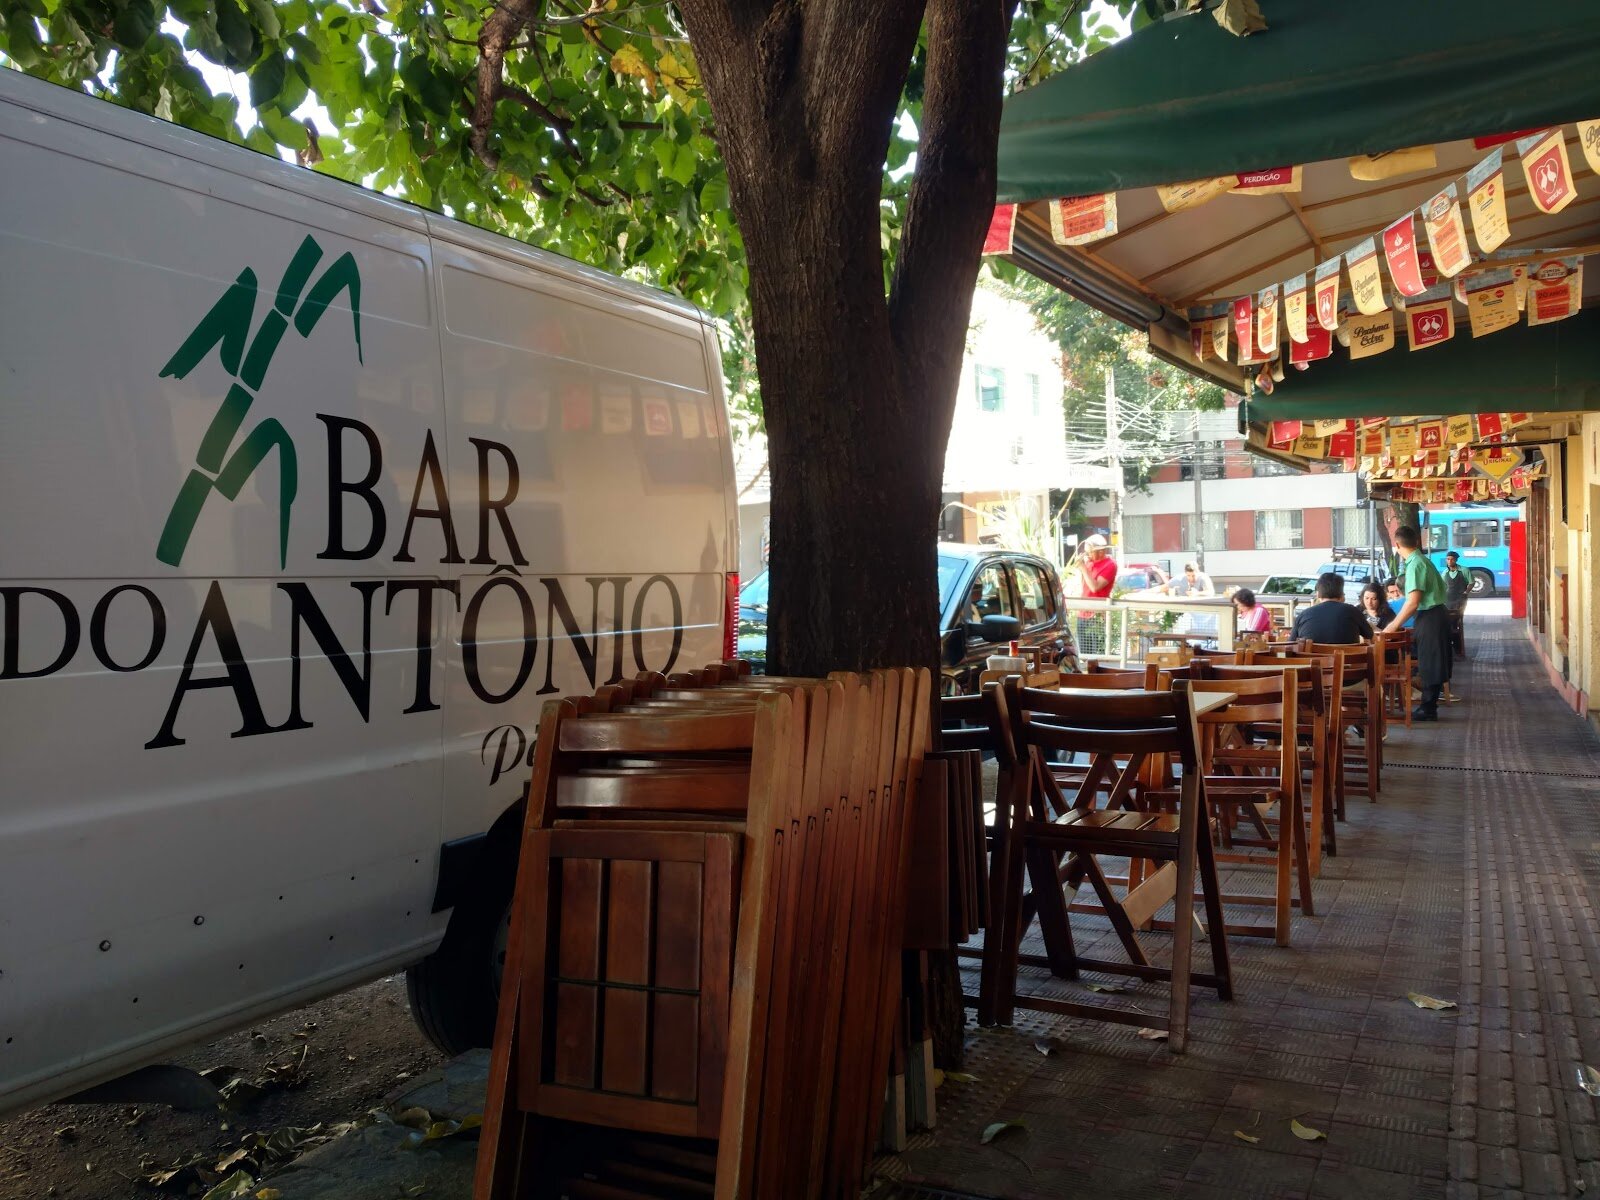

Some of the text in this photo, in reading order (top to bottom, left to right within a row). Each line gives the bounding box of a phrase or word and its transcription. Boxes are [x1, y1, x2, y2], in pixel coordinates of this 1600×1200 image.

[1244, 173, 1281, 183] PERDIGÃO
[1353, 323, 1390, 339] Brahma
[316, 413, 530, 567] BAR
[0, 564, 683, 750] DO ANTÔNIO
